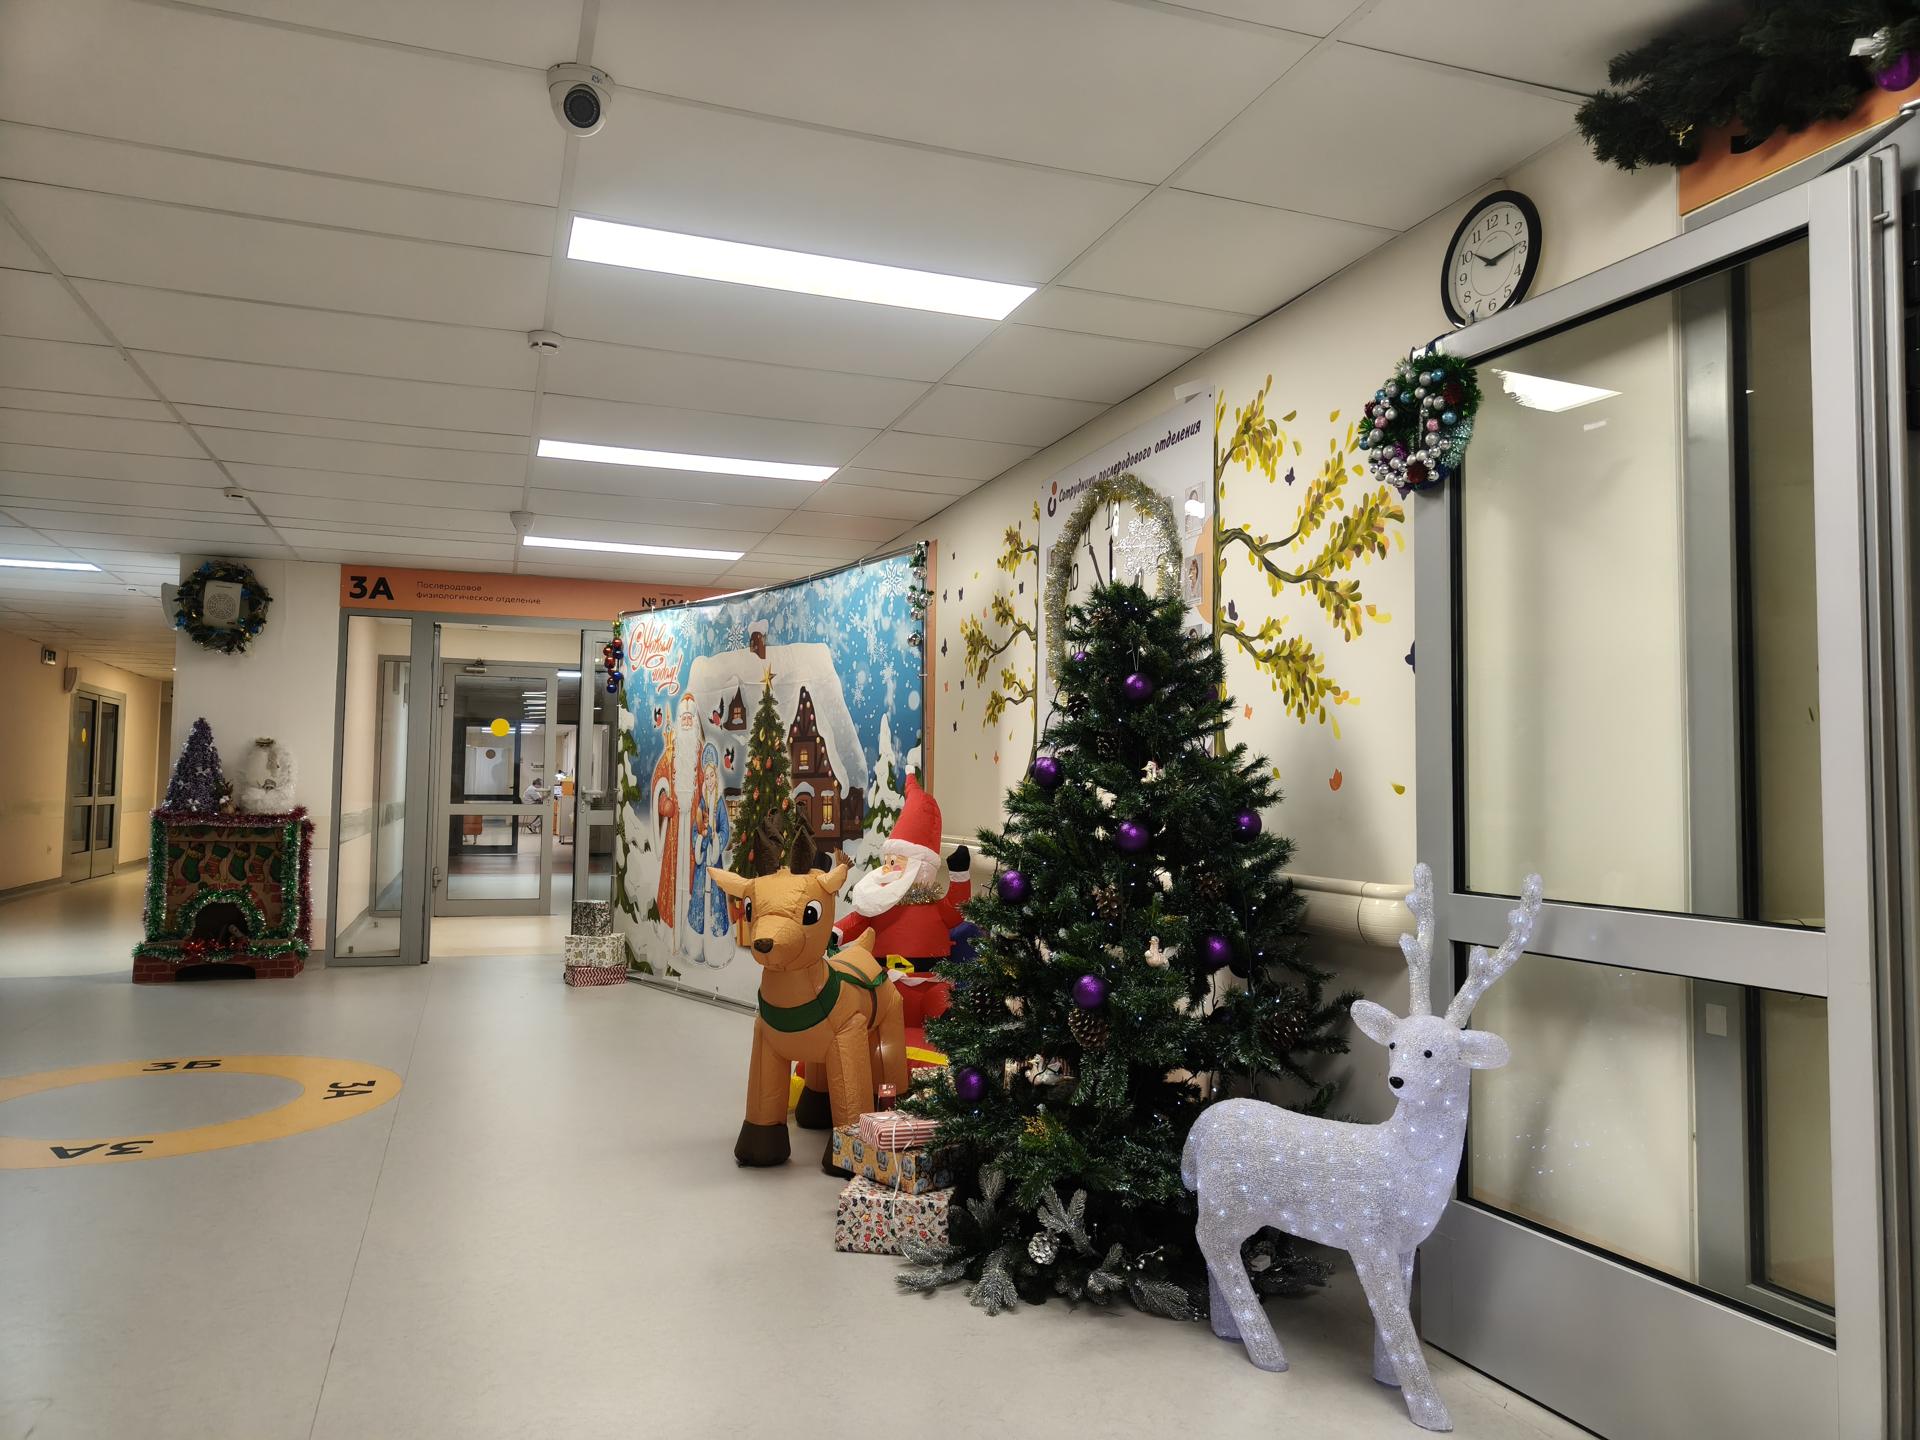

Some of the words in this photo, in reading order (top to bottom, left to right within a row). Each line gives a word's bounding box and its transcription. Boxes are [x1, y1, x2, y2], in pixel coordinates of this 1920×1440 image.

[1487, 214, 1498, 230] 12
[1505, 213, 1510, 225] 1
[1514, 221, 1523, 236] 2
[1472, 230, 1481, 244] 11
[1518, 240, 1527, 255] 3
[1461, 250, 1473, 265] 10
[1513, 263, 1521, 277] 4
[1459, 272, 1467, 286] 9
[1463, 290, 1471, 303] 8
[1503, 284, 1512, 299] 5
[1475, 298, 1482, 313] 7
[1488, 298, 1497, 311] 6
[1099, 446, 1152, 481] послеродового
[1154, 419, 1202, 454] отделения
[416, 580, 482, 592] Послеродовое
[416, 591, 494, 603] физиологическое
[495, 595, 541, 605] отделение
